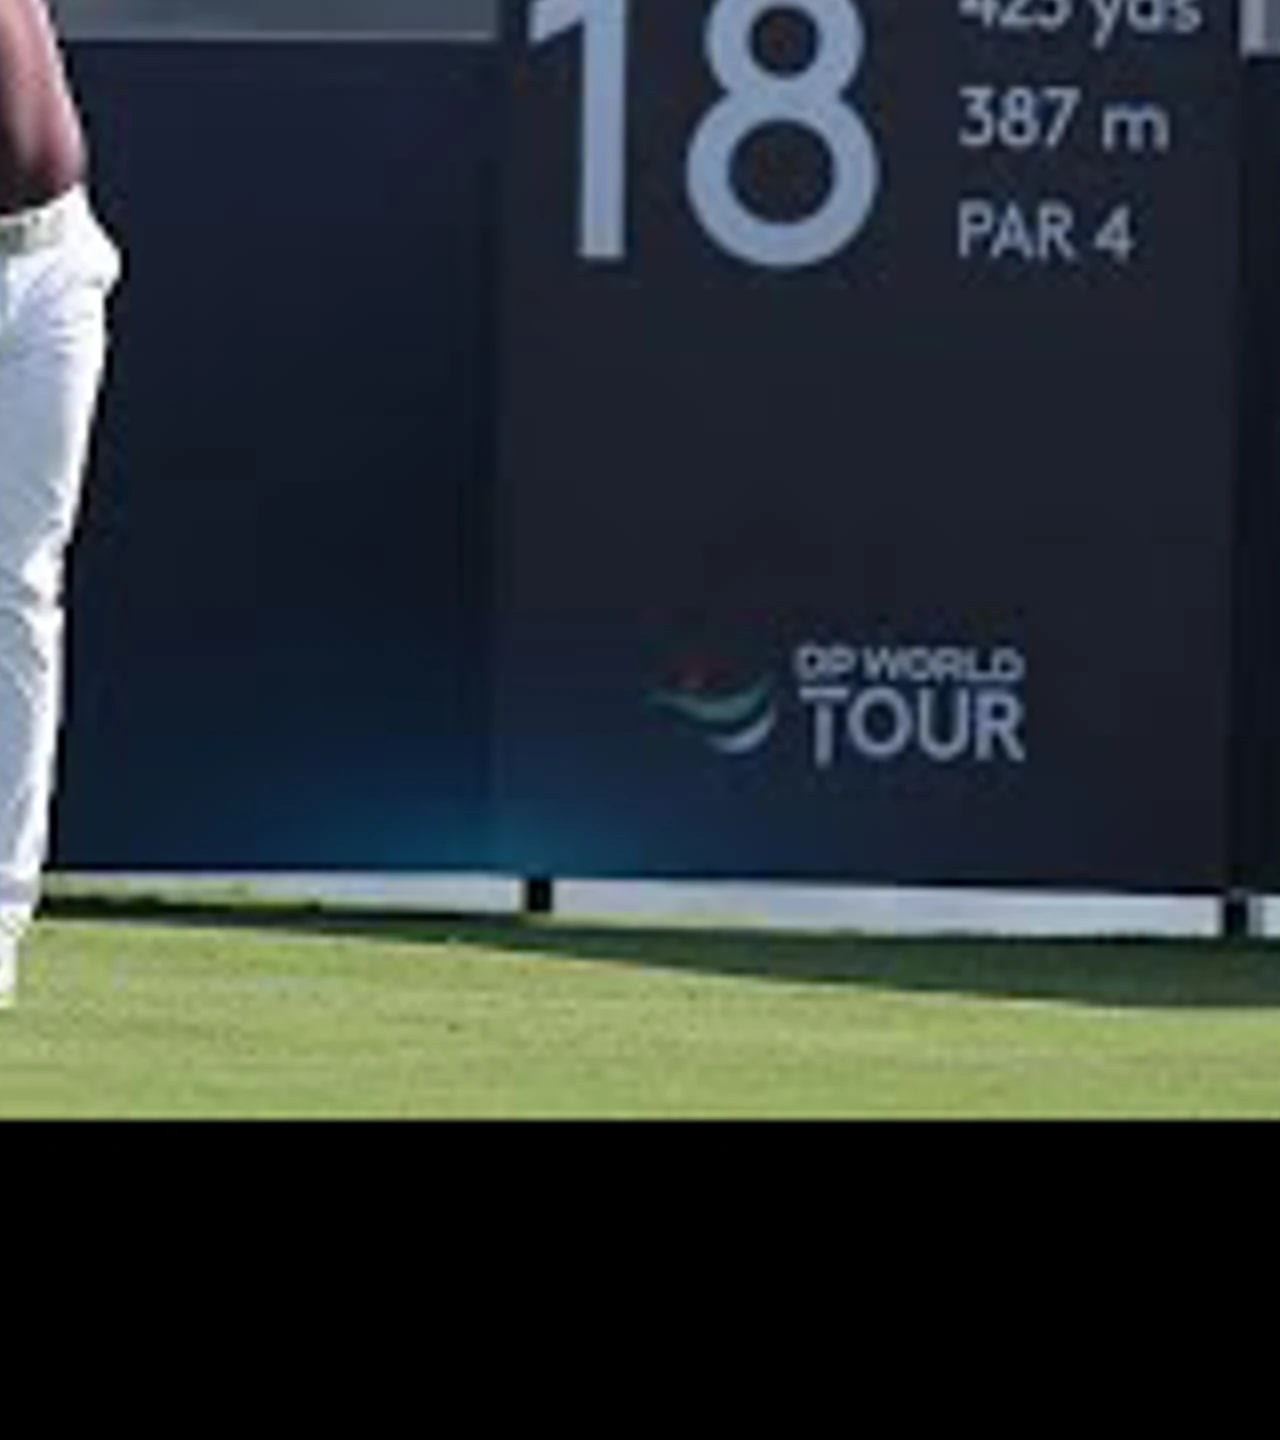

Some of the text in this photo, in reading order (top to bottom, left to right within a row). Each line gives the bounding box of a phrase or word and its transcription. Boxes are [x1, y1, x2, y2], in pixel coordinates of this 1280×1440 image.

[958, 85, 1170, 151] 387 m
[957, 199, 1135, 260] PAR 4
[795, 643, 1026, 683] DP WORLD
[797, 686, 1026, 766] TOUR
